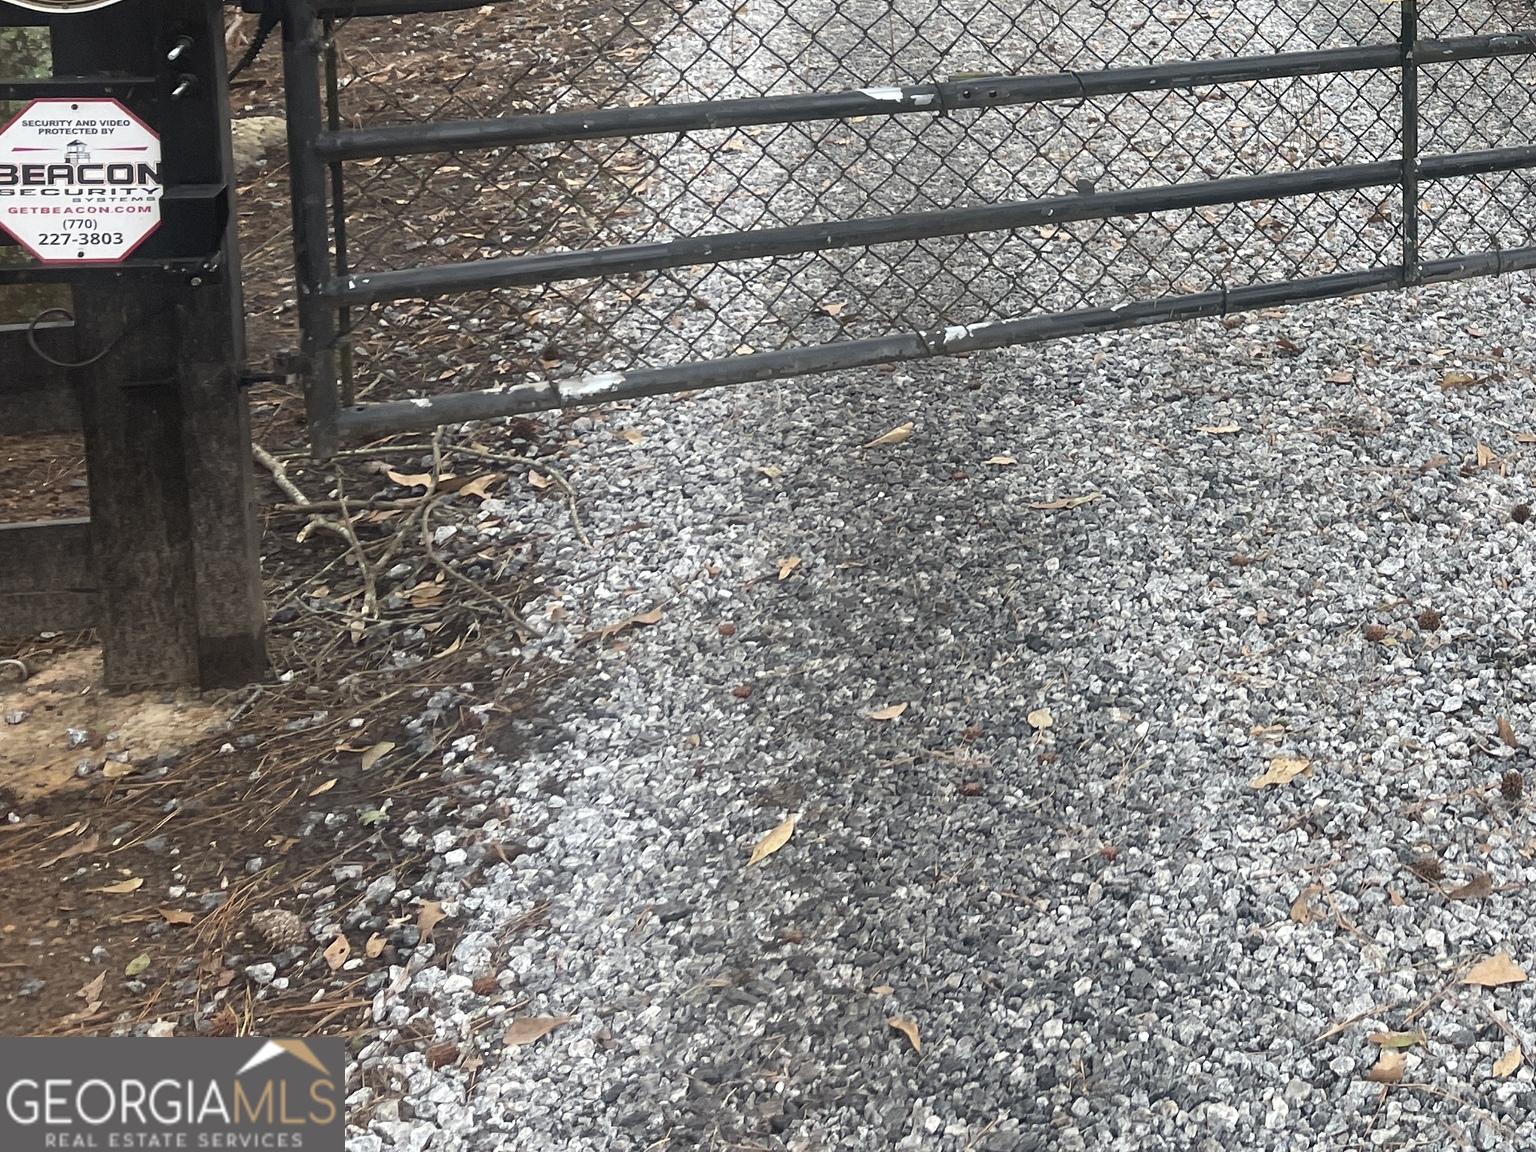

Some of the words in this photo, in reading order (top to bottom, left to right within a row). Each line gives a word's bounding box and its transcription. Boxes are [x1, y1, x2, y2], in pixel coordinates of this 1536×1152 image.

[22, 119, 73, 128] SECURITY
[75, 119, 97, 127] AND
[99, 119, 131, 127] VIDEO
[101, 127, 115, 135] BY
[0, 163, 161, 186] BEACON
[0, 188, 160, 196] SECURITY
[8, 206, 151, 215] GETBEACON.COM
[62, 219, 97, 230] (770)
[38, 233, 123, 245] 227-3803
